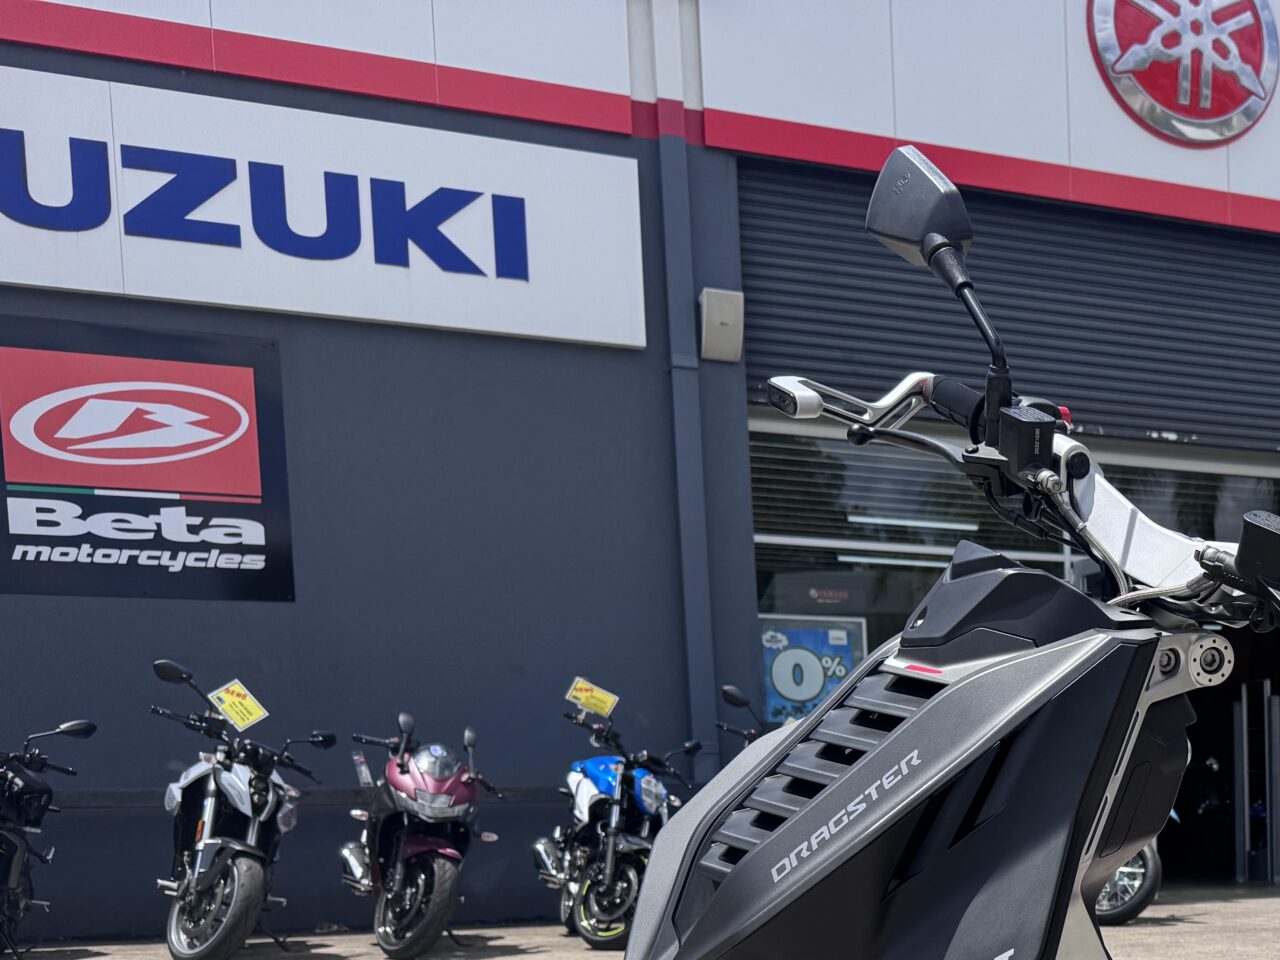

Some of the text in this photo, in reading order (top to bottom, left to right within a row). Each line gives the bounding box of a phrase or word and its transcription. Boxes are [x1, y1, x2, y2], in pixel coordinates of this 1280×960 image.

[7, 497, 265, 545] Beta
[12, 543, 265, 572] motorcycles
[772, 648, 847, 701] 0%
[771, 749, 922, 883] DRAGSTER
